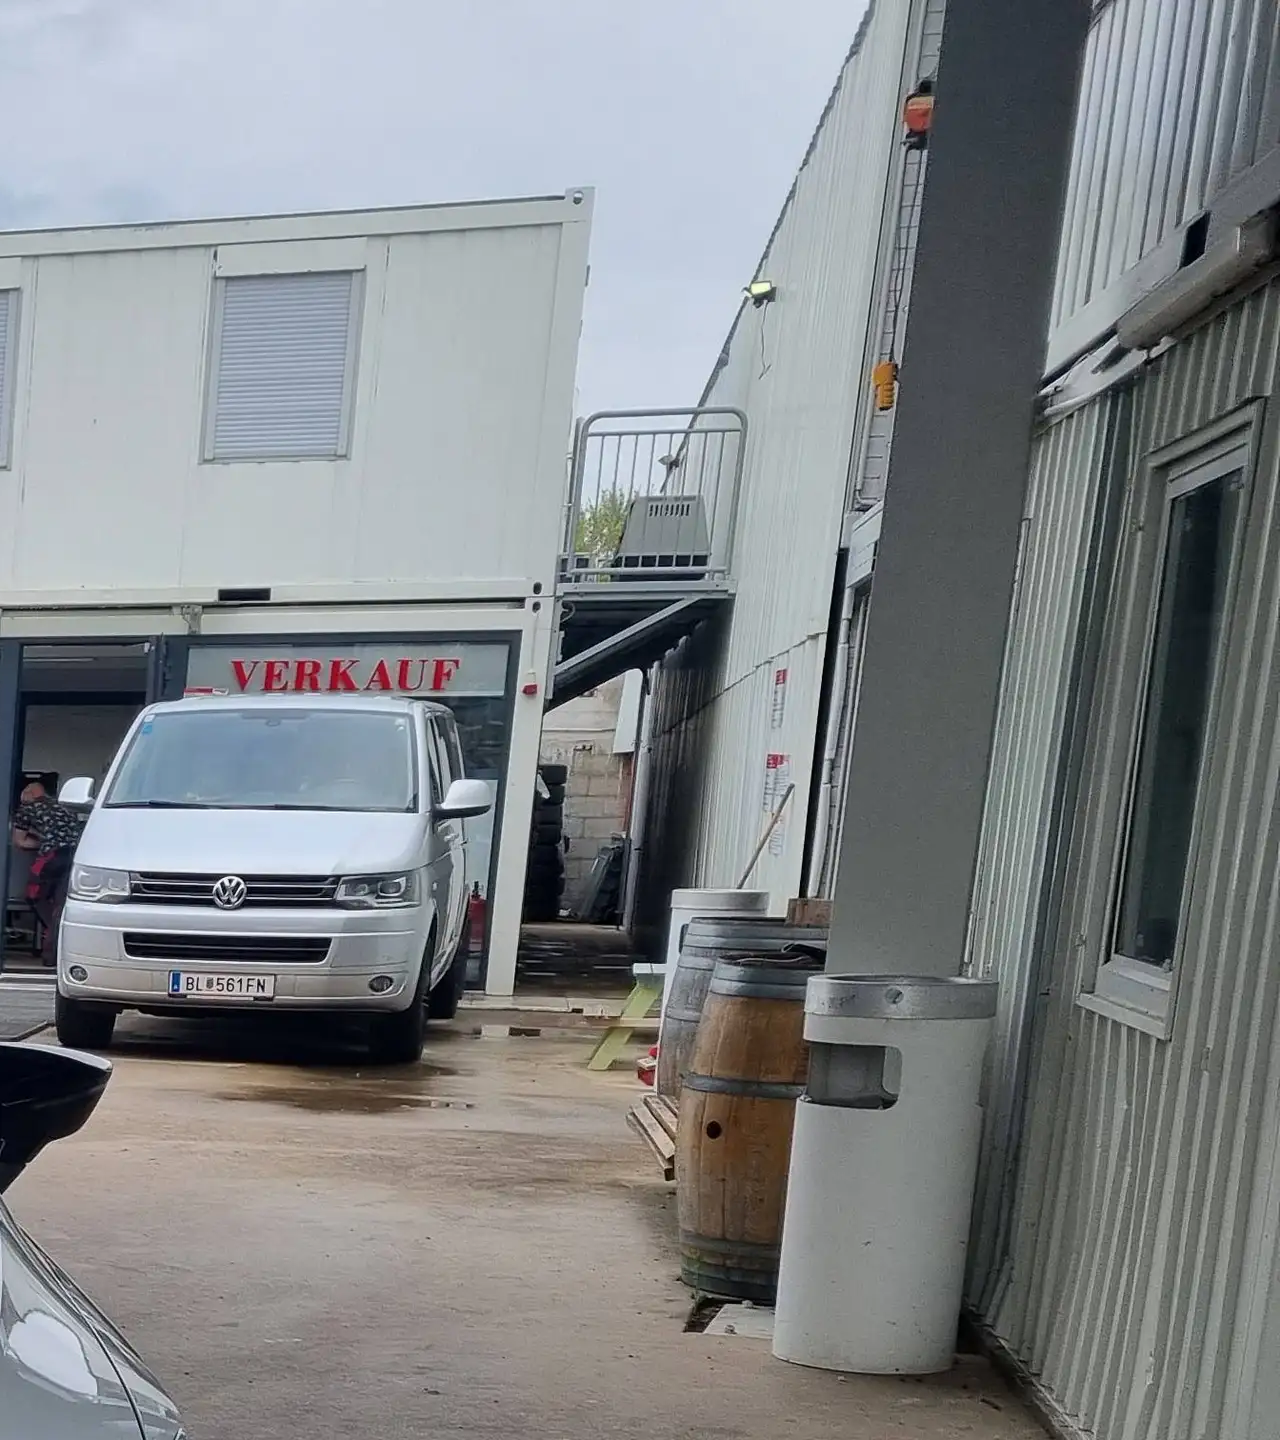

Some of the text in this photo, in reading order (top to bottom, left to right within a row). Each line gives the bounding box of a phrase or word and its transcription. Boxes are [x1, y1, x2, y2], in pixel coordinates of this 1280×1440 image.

[230, 658, 461, 692] VERKAUF
[185, 976, 266, 993] BL 561FN
